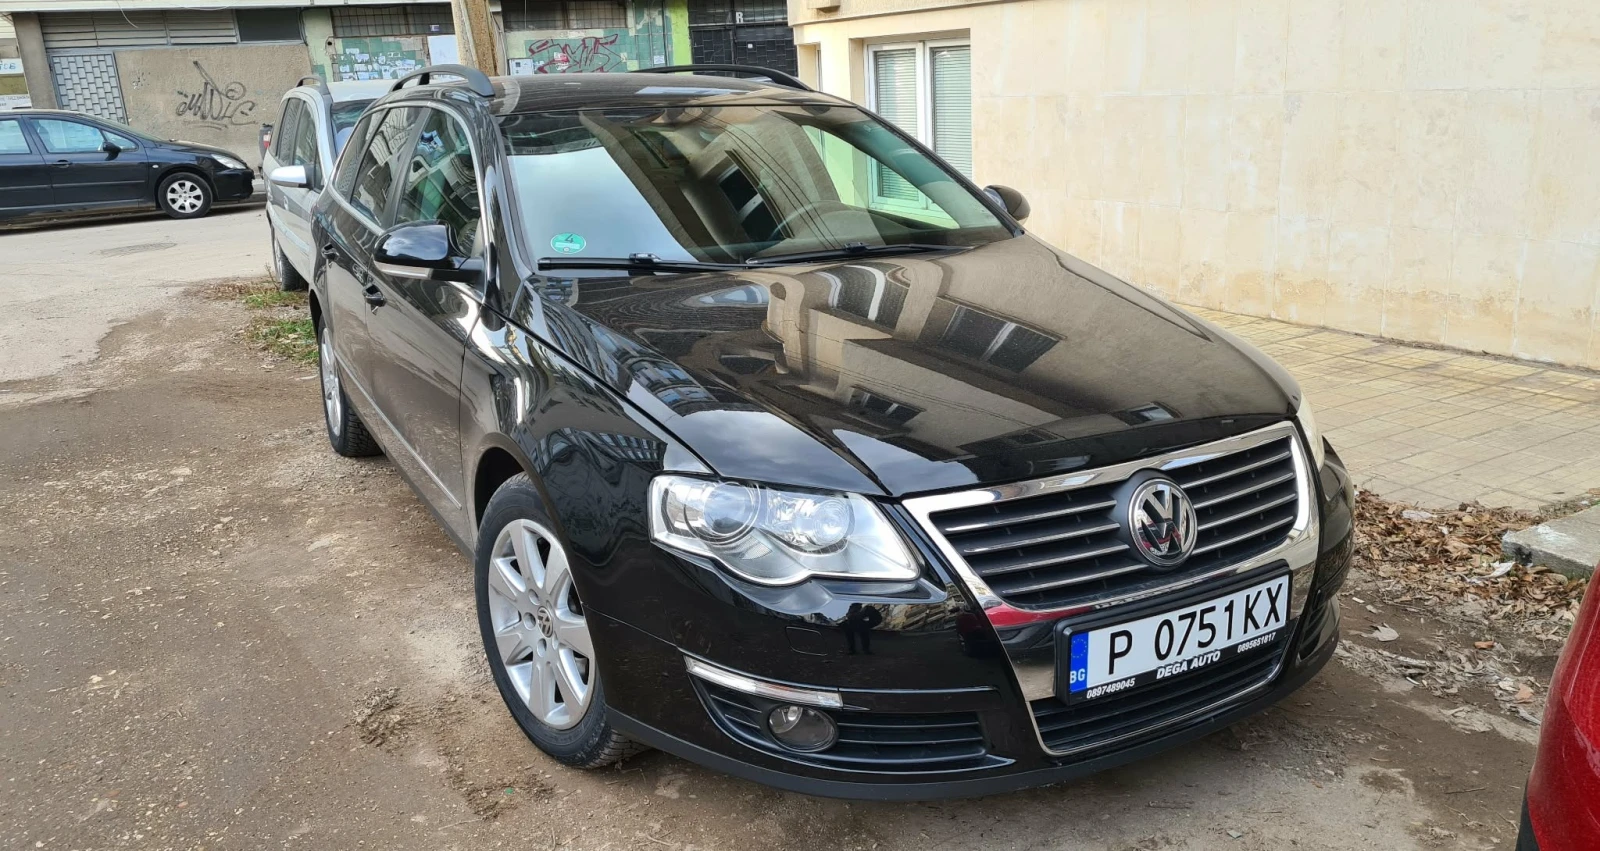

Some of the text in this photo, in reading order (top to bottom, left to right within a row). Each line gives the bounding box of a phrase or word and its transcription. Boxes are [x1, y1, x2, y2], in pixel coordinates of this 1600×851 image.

[735, 11, 744, 24] R
[564, 233, 574, 244] 4
[1108, 583, 1283, 675] P 0751KX
[1156, 650, 1221, 680] DEGA AUTO
[1069, 668, 1086, 684] BG
[1086, 677, 1136, 699] 0897489045
